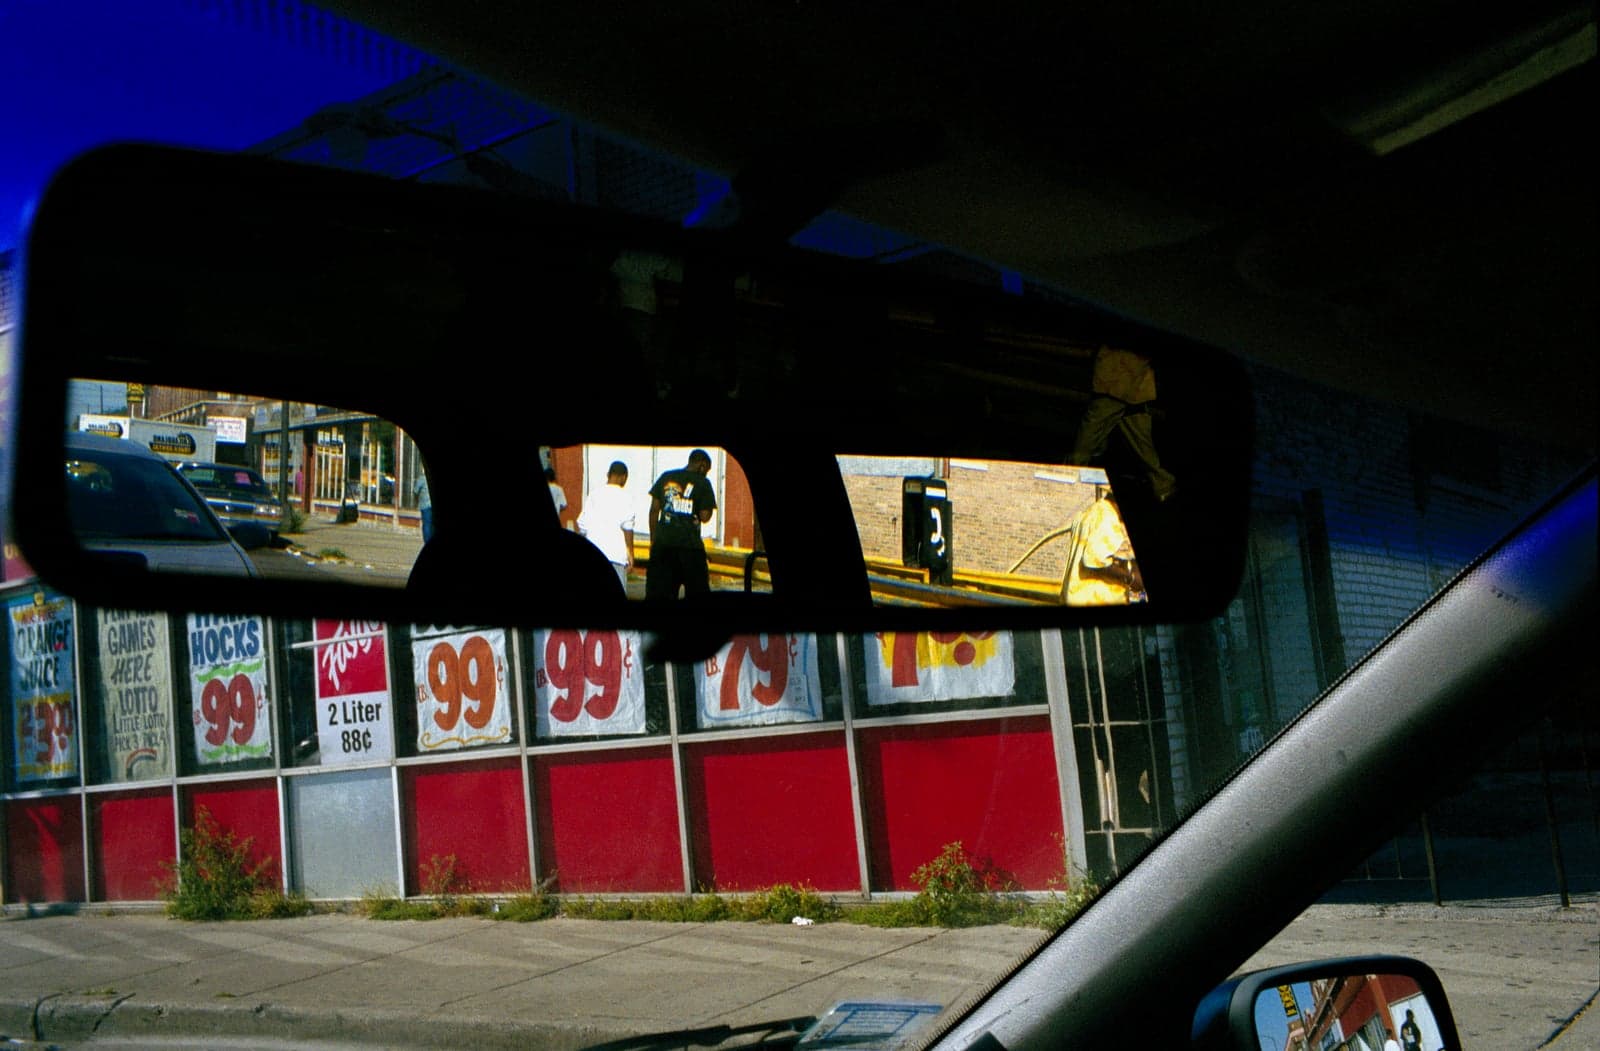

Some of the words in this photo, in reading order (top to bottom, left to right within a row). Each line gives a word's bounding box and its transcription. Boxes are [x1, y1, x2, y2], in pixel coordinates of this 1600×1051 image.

[108, 619, 156, 656] GAMES
[191, 619, 260, 666] HOCKS
[111, 652, 153, 686] HERE
[118, 685, 159, 717] LOTTO
[328, 703, 339, 726] 2
[342, 700, 382, 724] Liter
[341, 728, 372, 753] 88¢
